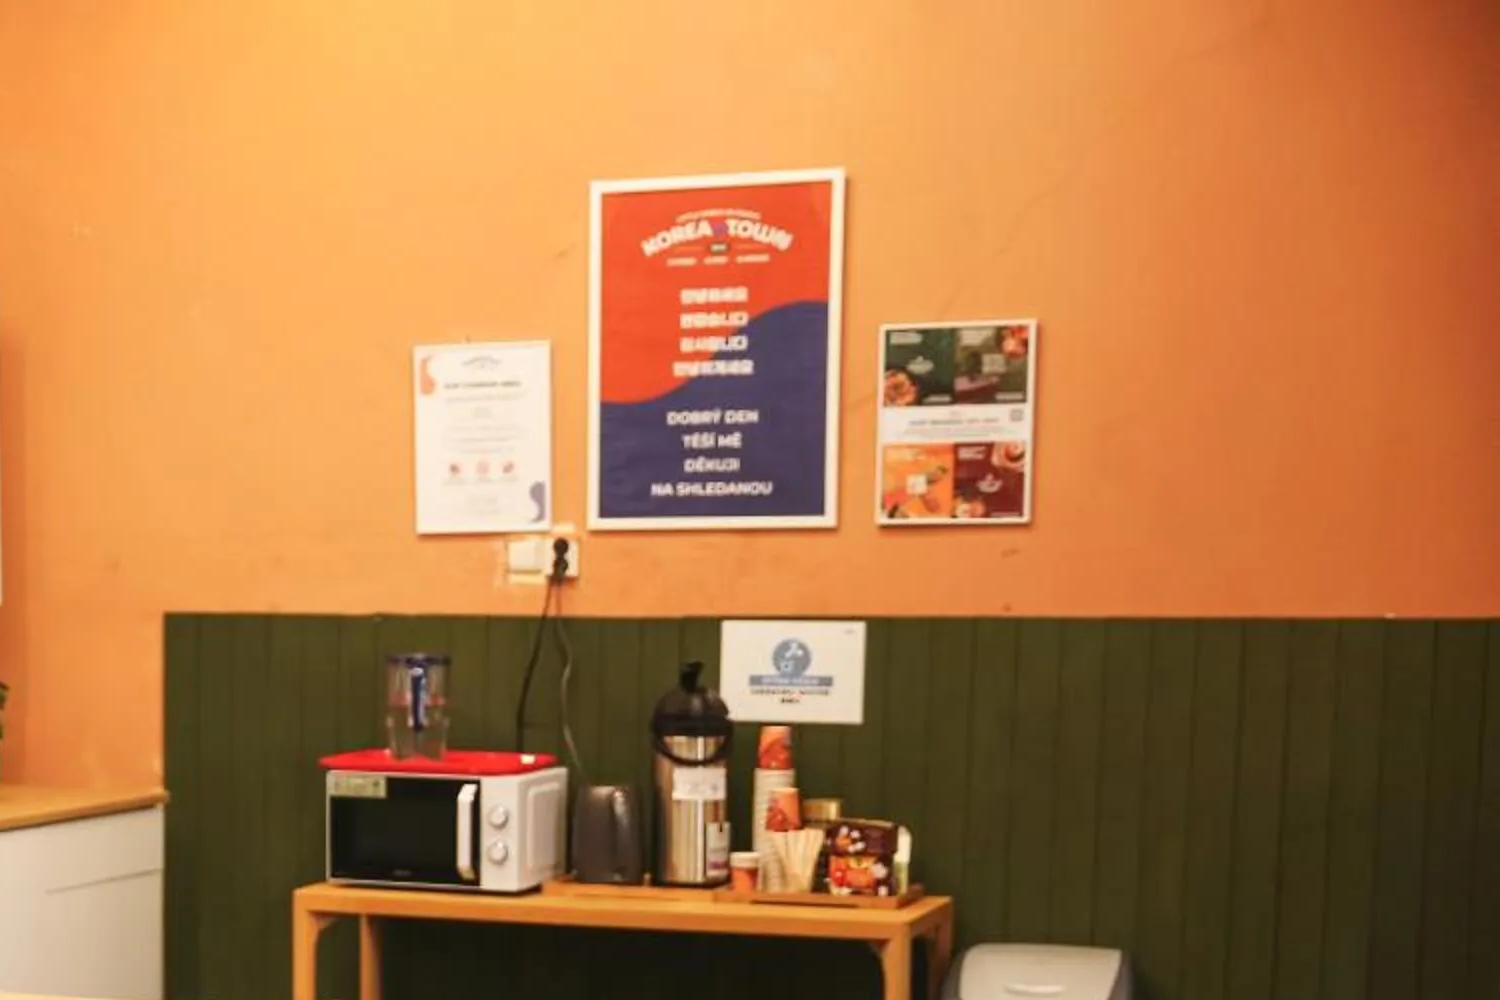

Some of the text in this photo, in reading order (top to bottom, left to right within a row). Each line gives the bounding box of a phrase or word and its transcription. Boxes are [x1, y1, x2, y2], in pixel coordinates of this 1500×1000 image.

[641, 219, 714, 256] KOREA
[666, 407, 760, 426] DOBRÝ DEN
[651, 480, 773, 497] NA SHLEDANOU
